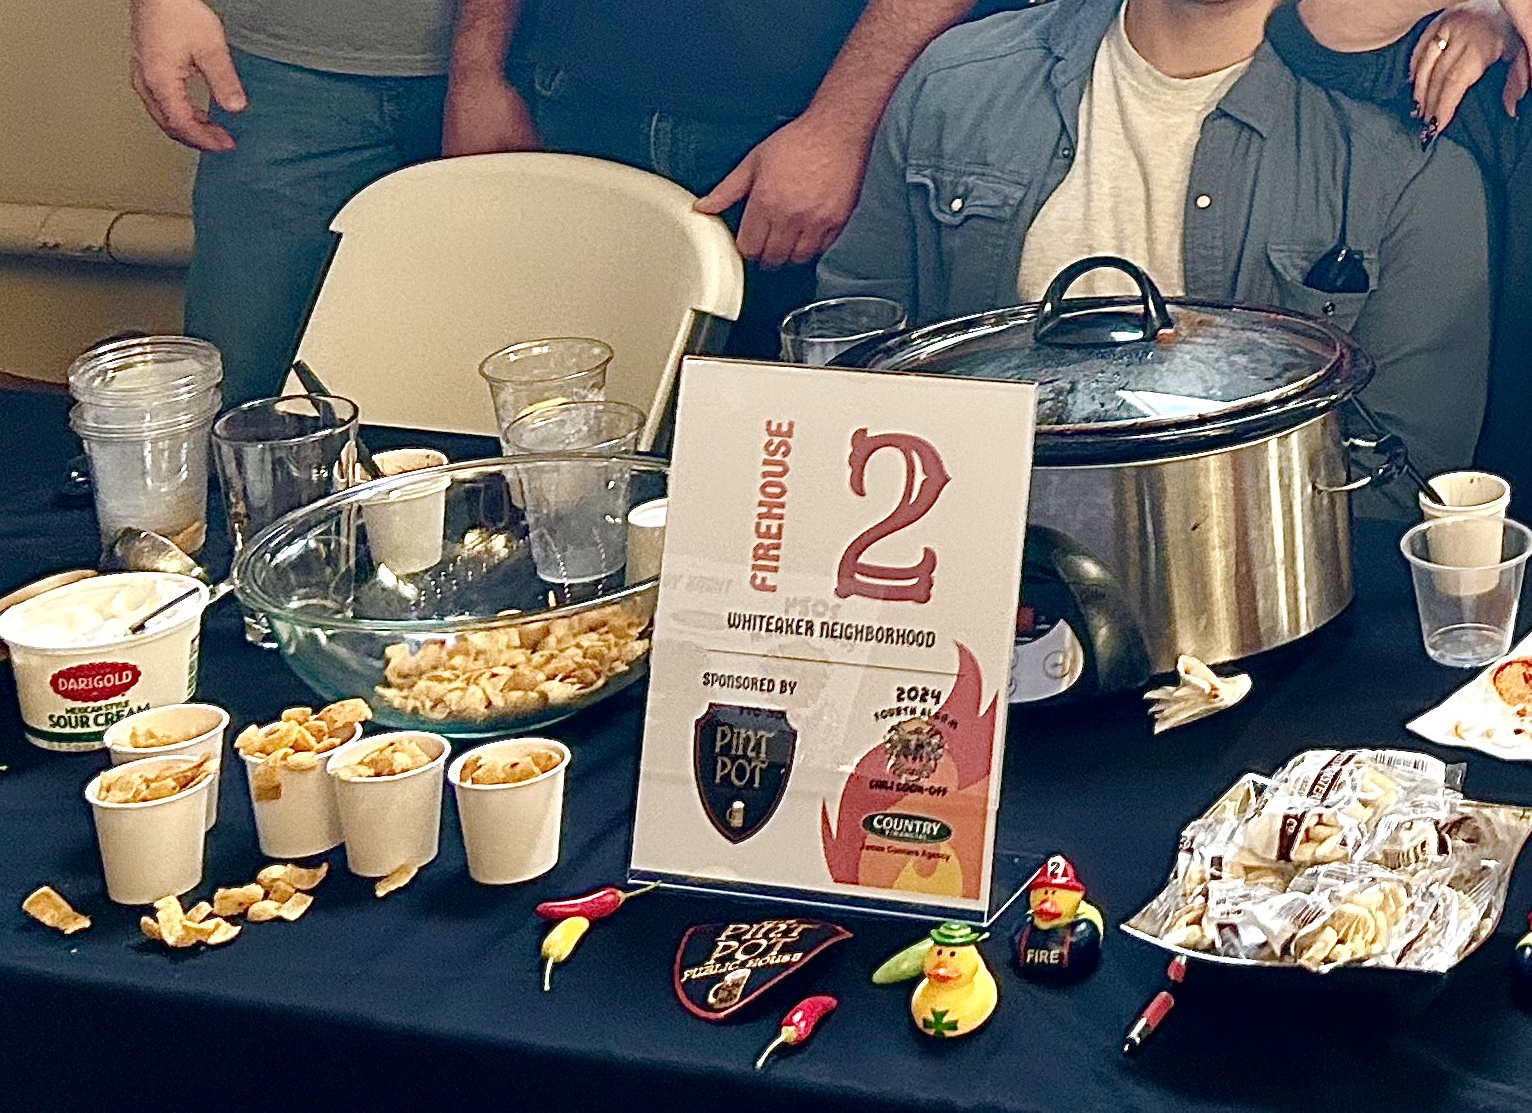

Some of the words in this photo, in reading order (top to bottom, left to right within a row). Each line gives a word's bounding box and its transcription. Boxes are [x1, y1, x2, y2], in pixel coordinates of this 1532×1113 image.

[750, 419, 795, 593] FIREHOUSE
[835, 427, 952, 604] 2
[727, 612, 815, 637] WHITEAKER
[819, 621, 936, 648] NEIGHBORHOOD
[57, 670, 133, 692] DARIGOLD
[702, 672, 775, 693] SPONSORED
[779, 679, 797, 695] BY
[896, 686, 941, 705] 2024
[65, 705, 102, 715] MEXICAN
[103, 700, 130, 709] STYLE
[48, 714, 91, 729] SOUR
[715, 725, 775, 760] PINT
[715, 756, 769, 788] POT
[872, 815, 942, 836] COUNTRY
[715, 923, 823, 941] PINT
[706, 936, 800, 965] POT
[1025, 949, 1061, 964] FIRE
[680, 961, 740, 983] PUBLIC
[744, 953, 803, 969] HOUSE
